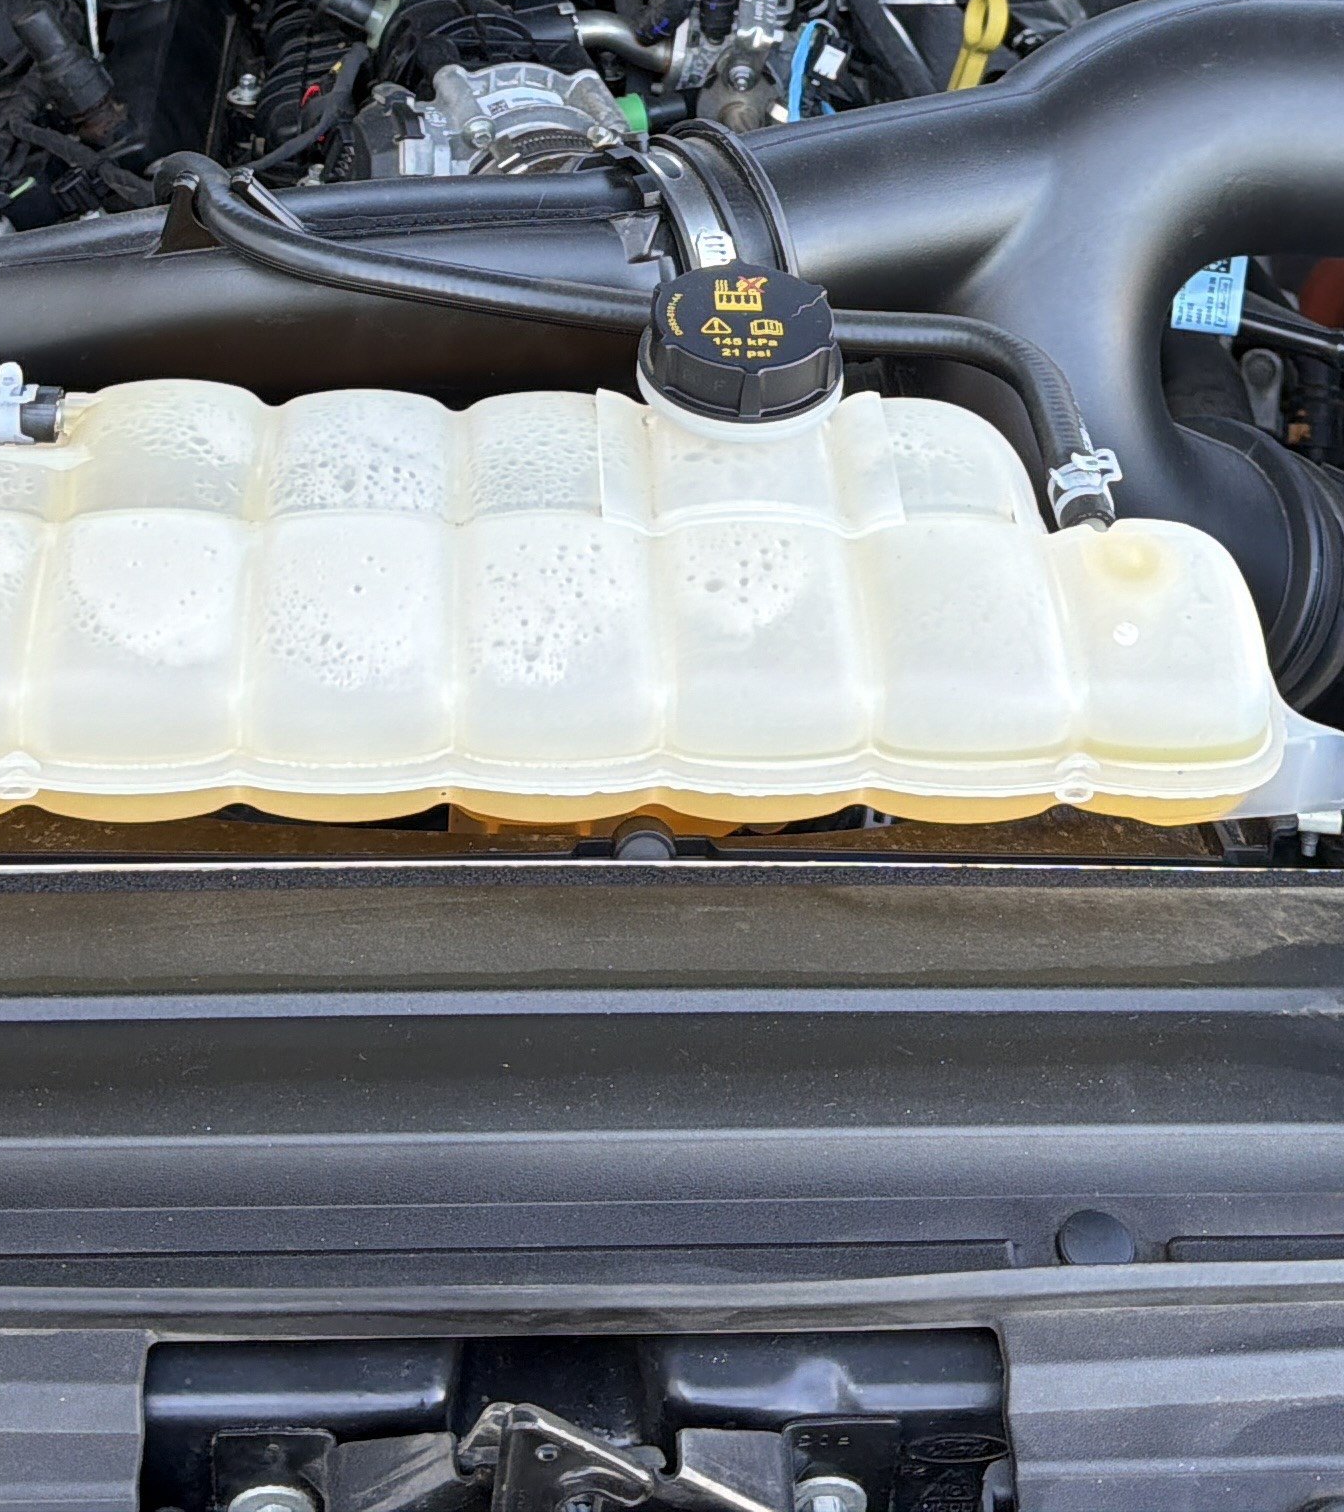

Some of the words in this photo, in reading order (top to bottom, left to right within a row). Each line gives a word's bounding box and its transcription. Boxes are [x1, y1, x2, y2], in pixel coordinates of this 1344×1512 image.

[712, 337, 742, 346] 145
[746, 337, 779, 347] kPa
[721, 347, 740, 358] 21
[746, 348, 772, 359] psi
